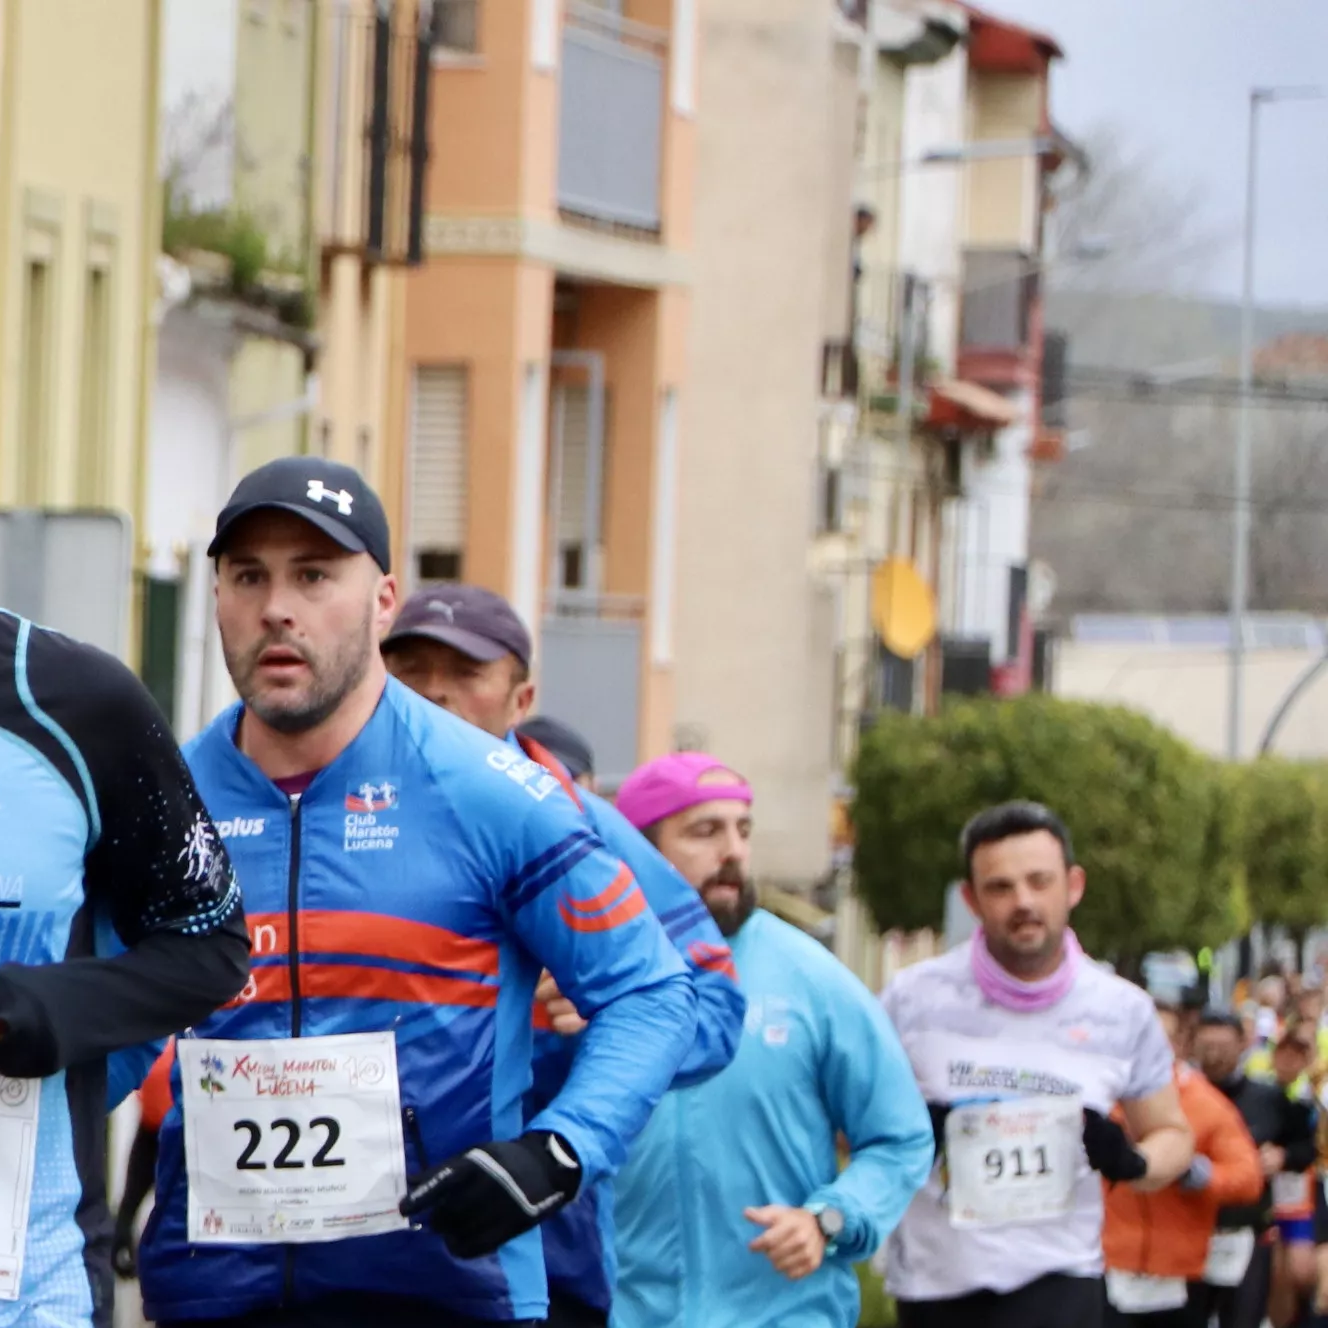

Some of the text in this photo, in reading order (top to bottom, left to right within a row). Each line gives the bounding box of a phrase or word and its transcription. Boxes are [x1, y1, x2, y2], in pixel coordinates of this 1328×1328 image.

[345, 813, 377, 827] Club
[345, 824, 399, 839] Maratón
[345, 837, 395, 851] Lucena
[256, 1077, 324, 1097] LUCENA
[233, 1115, 347, 1171] 222
[984, 1145, 1053, 1181] 911
